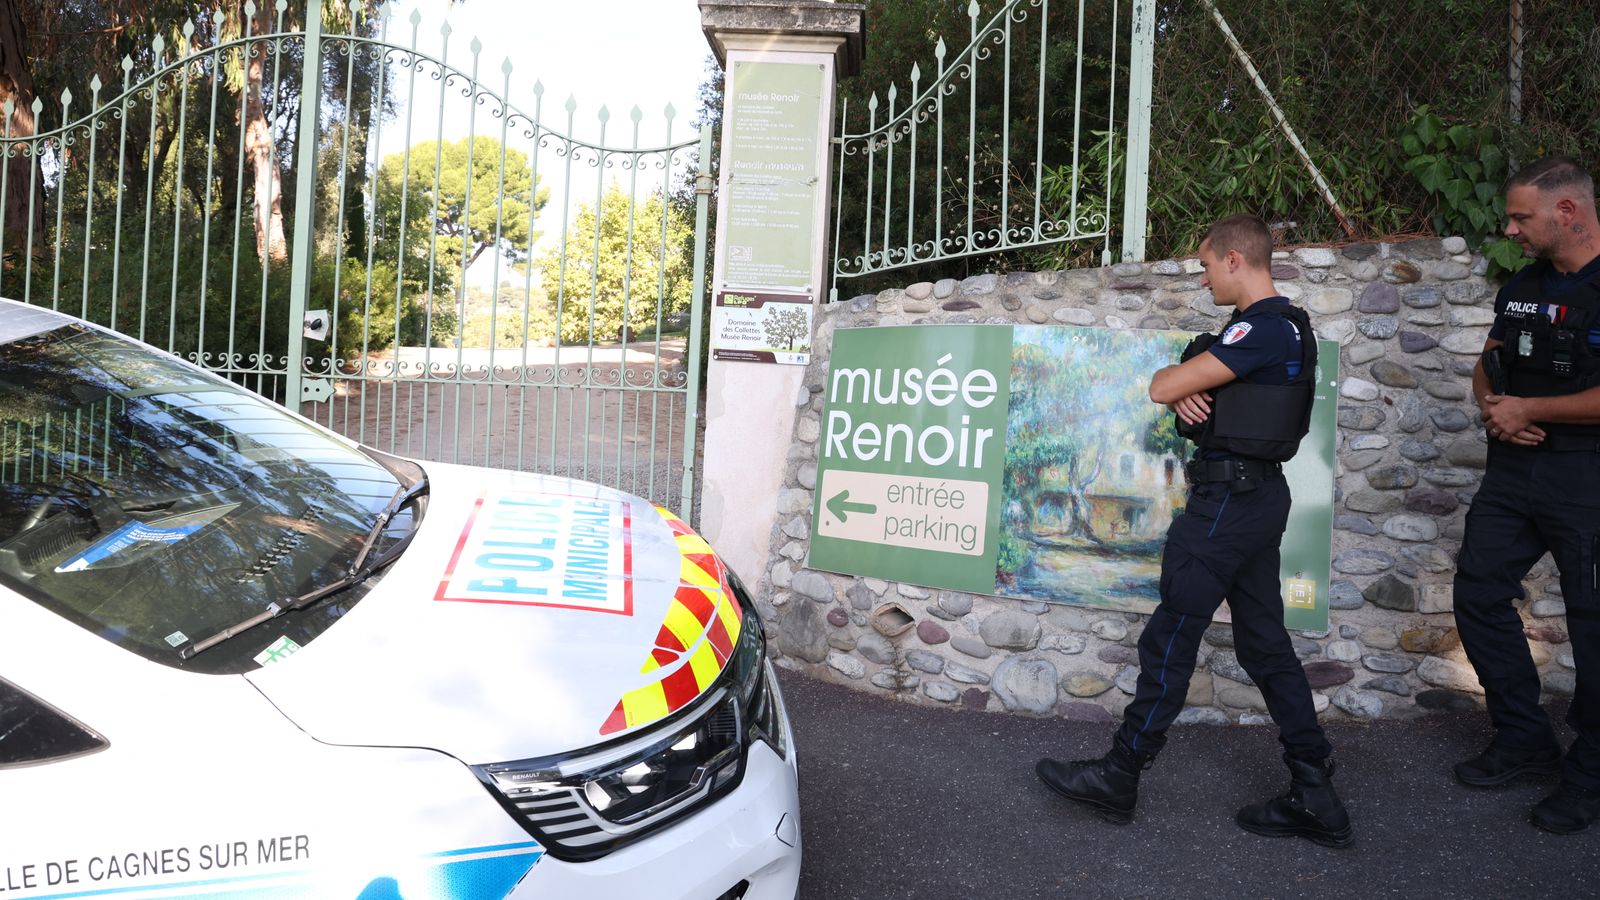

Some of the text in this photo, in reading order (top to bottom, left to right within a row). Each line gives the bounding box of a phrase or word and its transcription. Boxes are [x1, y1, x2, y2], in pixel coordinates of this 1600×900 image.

[770, 93, 800, 103] Renoir
[734, 160, 763, 170] Renoir
[727, 318, 757, 326] Domaine
[1506, 301, 1538, 314] POLICE
[720, 333, 741, 341] Musée
[830, 352, 998, 409] musée
[824, 410, 993, 469] Renoir
[887, 481, 965, 510] entrée
[466, 495, 564, 596] POLICE
[883, 515, 978, 551] parking
[562, 500, 610, 601] MUNICIPALE
[512, 772, 540, 780] RENAULT
[46, 859, 80, 886] DE
[88, 847, 191, 882] CAGNES
[199, 841, 248, 870] SUR
[257, 834, 310, 864] MER
